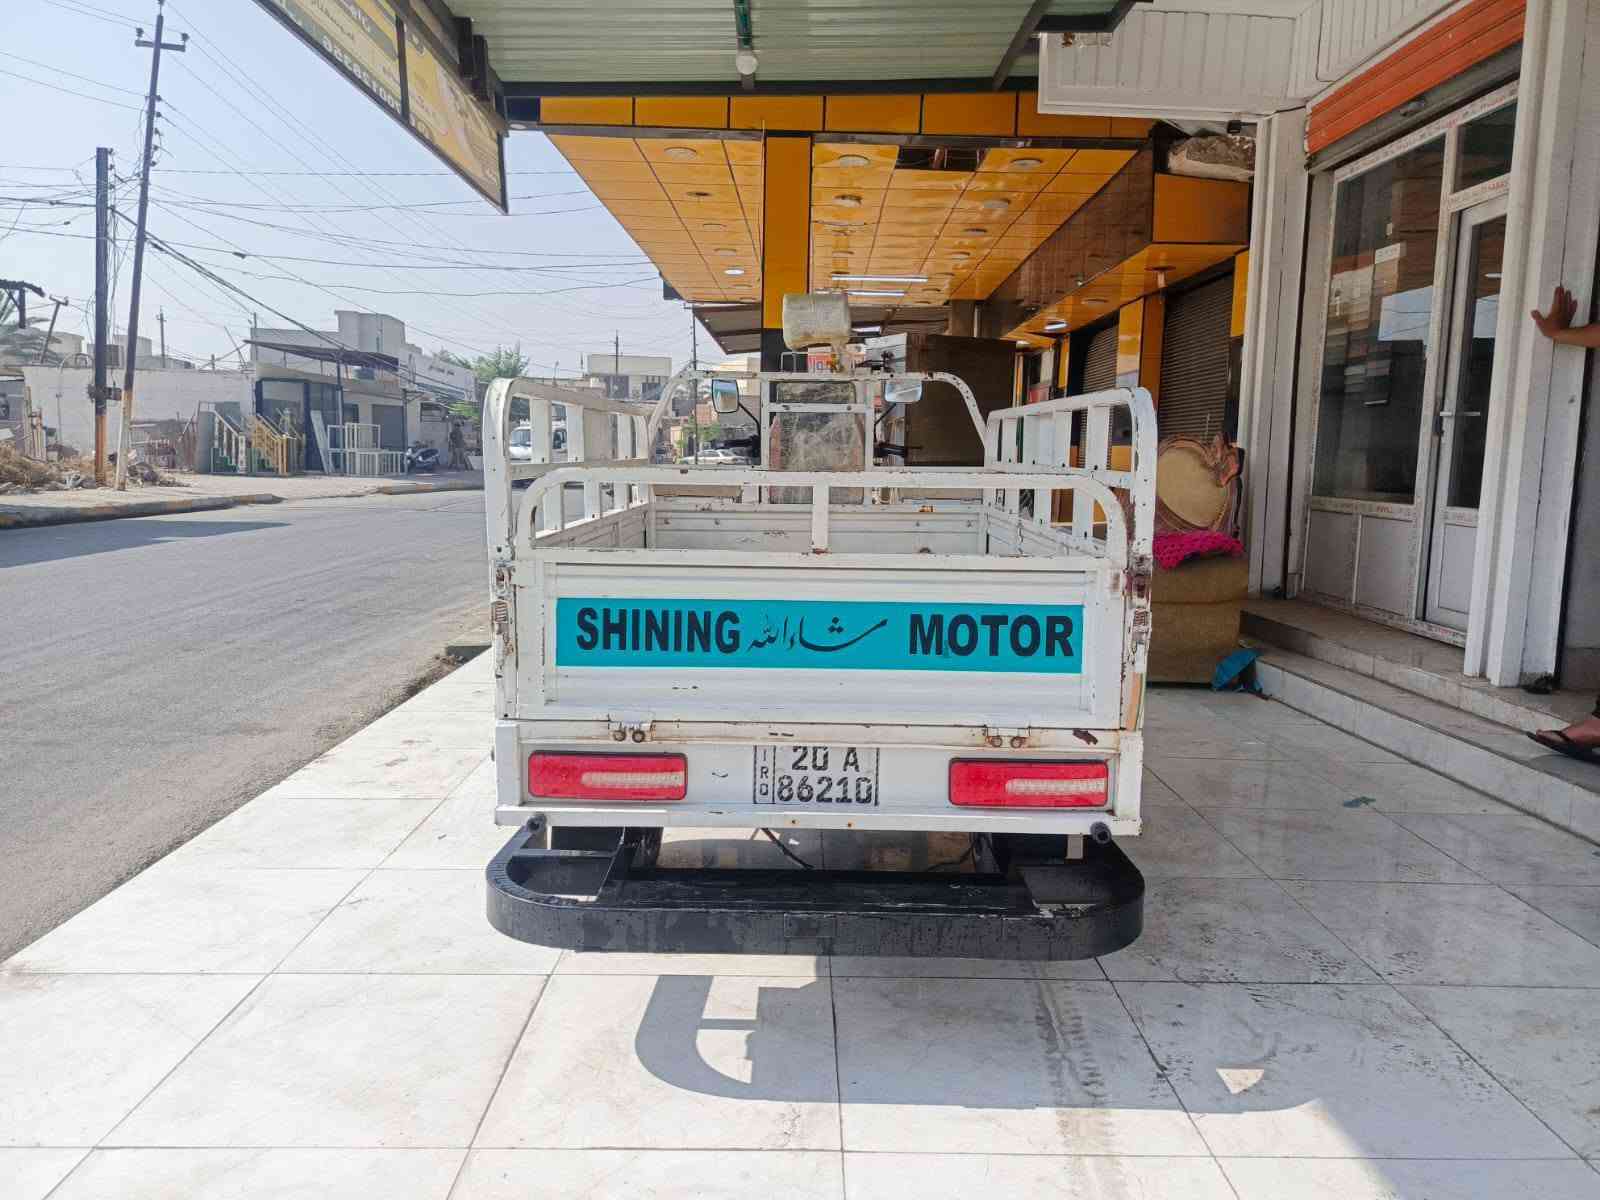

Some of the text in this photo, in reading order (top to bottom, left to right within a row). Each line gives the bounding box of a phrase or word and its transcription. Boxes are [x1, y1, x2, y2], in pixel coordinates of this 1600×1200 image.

[576, 607, 740, 654] SHINING
[909, 613, 1074, 657] MOTOR
[791, 746, 860, 772] 20 A
[777, 775, 873, 804] 86210
